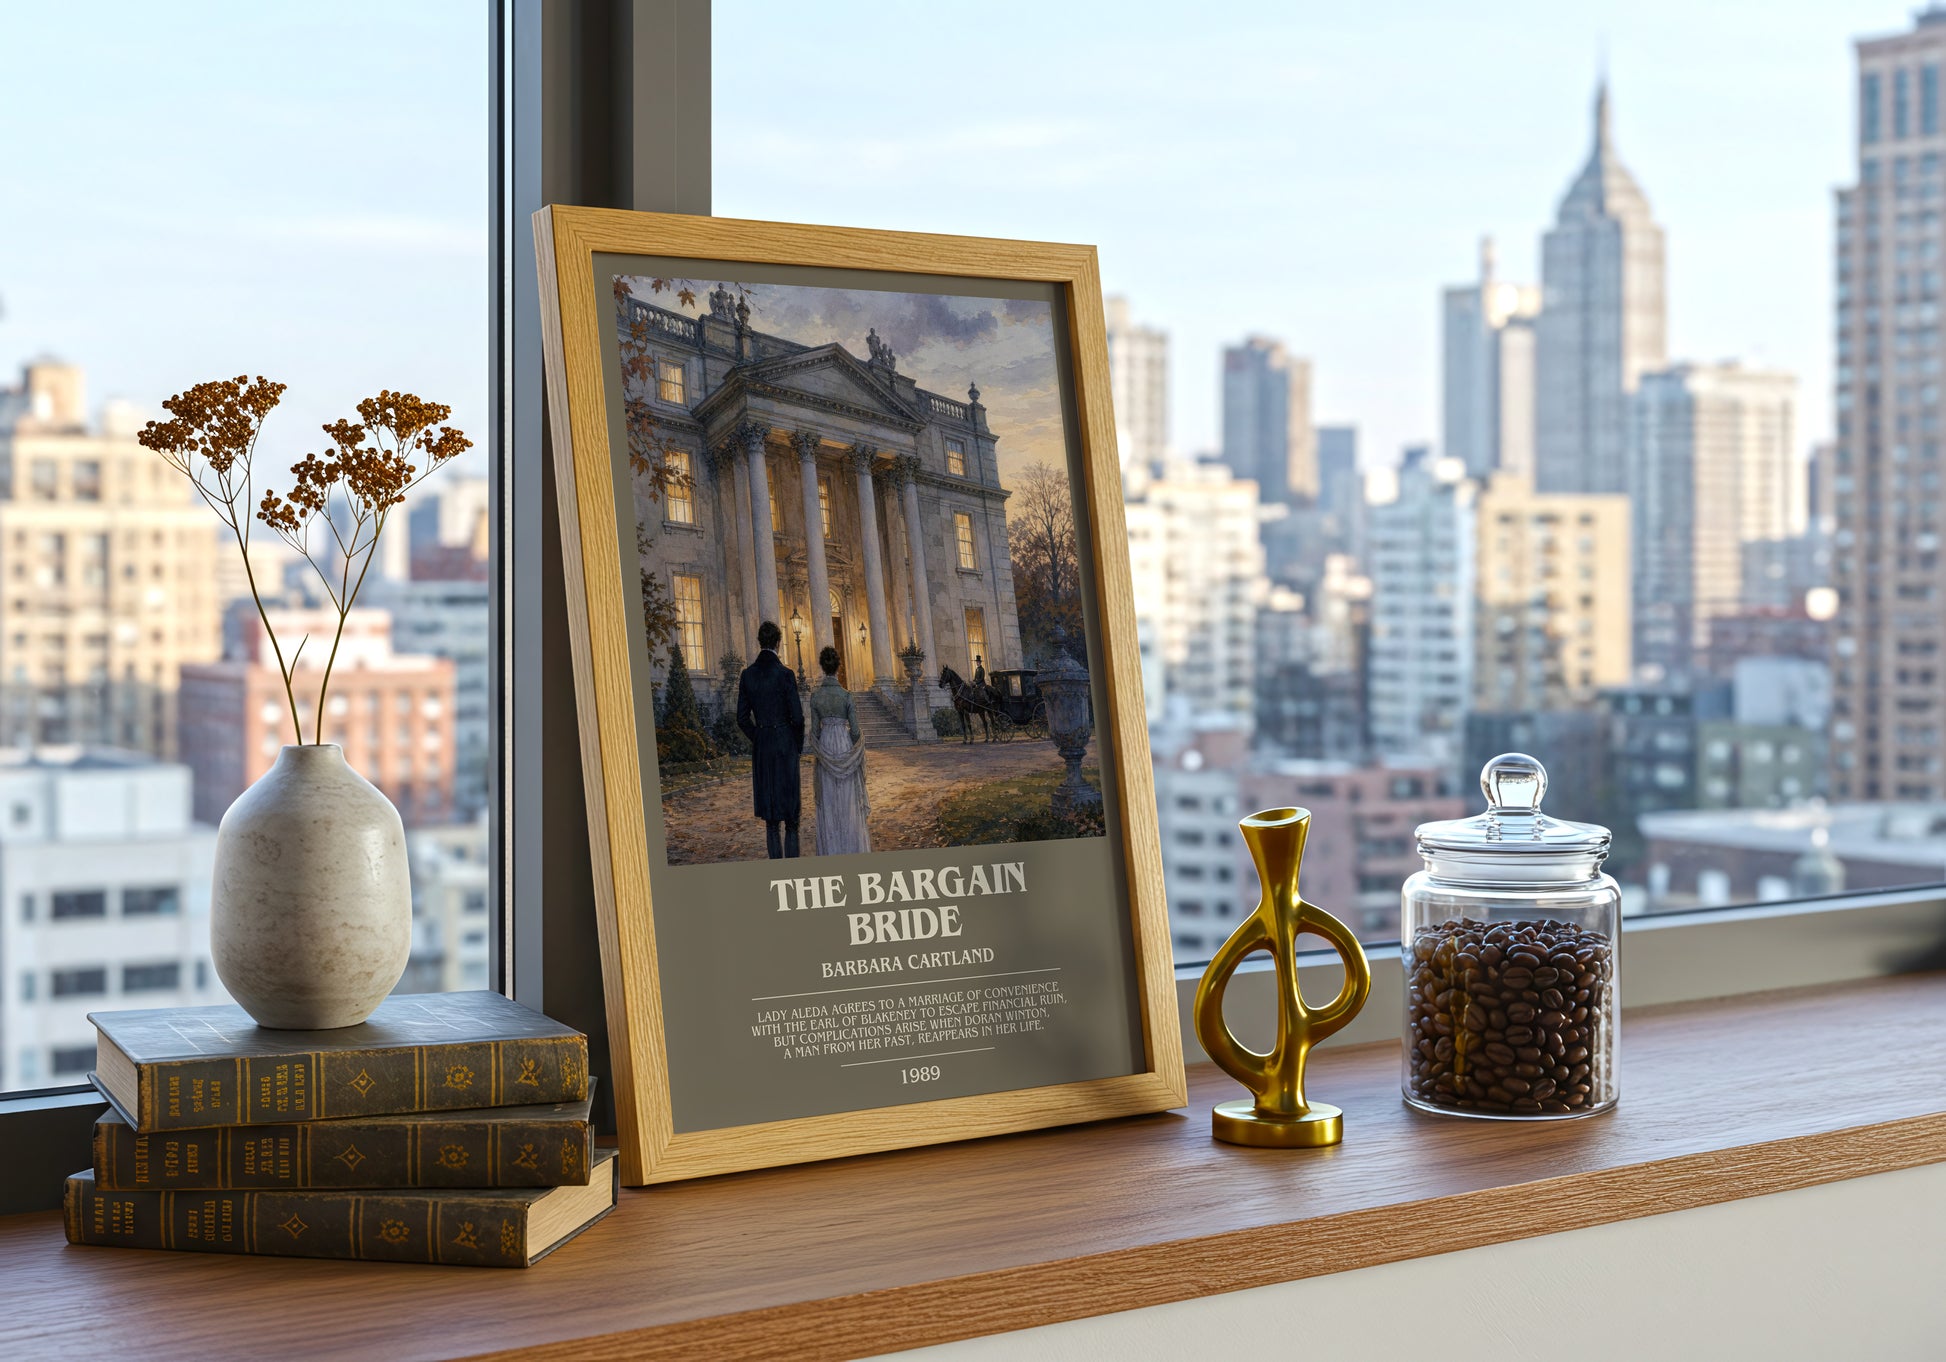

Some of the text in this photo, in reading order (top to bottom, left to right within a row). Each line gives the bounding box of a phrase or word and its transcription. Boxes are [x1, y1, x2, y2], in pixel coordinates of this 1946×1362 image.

[770, 862, 1027, 911] THE BARGAIN
[847, 905, 963, 946] BRIDE
[822, 948, 994, 978] BARBARA CARTLAND
[752, 993, 1067, 1036] WITH THE EARL OF BLAKENEY TO ESCAPE FINANCIAL RUIN,
[758, 982, 1059, 1023] LADY ALEDA AGREES TO A MARRIAGE OF CONVENIENCE
[774, 1008, 1050, 1047] BUT COMPLICATIONS ARISE WHEN DORAN WINTON,
[784, 1020, 1044, 1059] A MAN FROM HER PAST, REAPPEARS IN HER LIFE.
[901, 1066, 941, 1084] 1989
